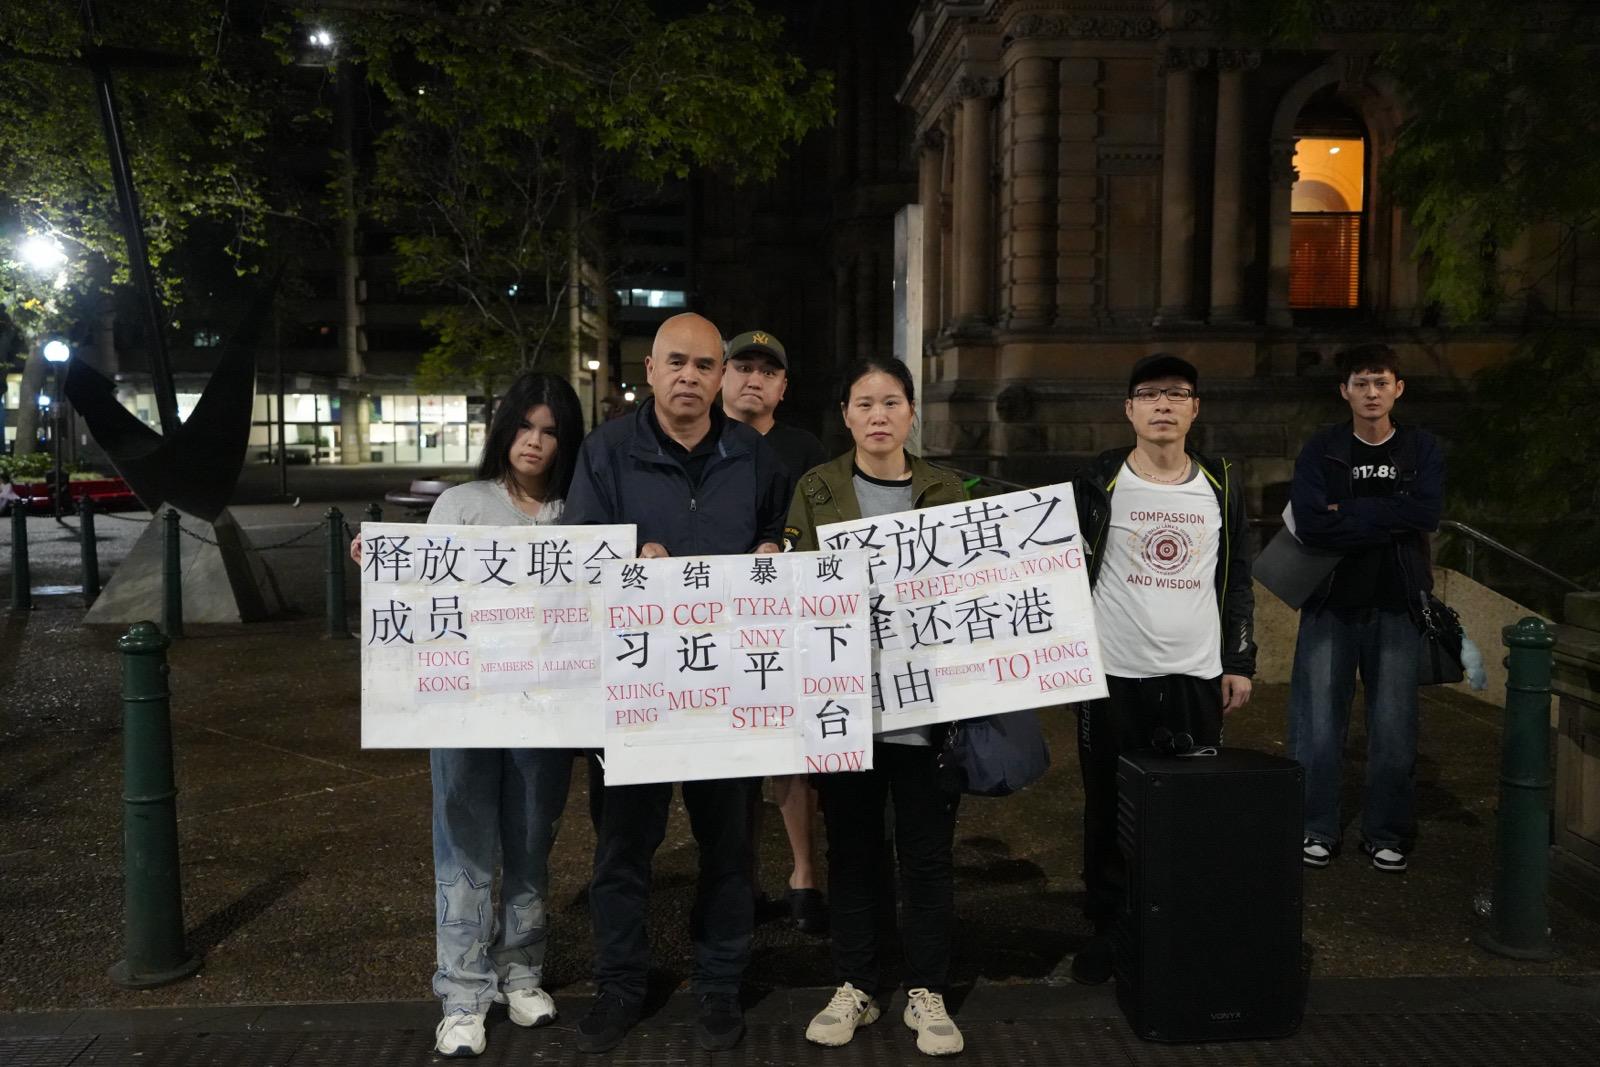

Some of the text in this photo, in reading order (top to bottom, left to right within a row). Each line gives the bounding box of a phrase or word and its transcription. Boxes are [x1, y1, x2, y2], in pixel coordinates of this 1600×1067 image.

[752, 332, 769, 345] NY
[1130, 511, 1205, 525] COMPASSION
[364, 535, 623, 586] 释放支联会
[621, 554, 844, 591] 终结暴政
[895, 548, 1083, 601] FREE JOSHUA WONG
[1126, 573, 1201, 589] AND WISDOM
[368, 595, 467, 646] 成员
[470, 606, 589, 624] RESTORE FREE
[608, 594, 861, 629] END CCP TYRA NOW
[740, 629, 786, 648] NNY
[418, 650, 470, 668] HONG
[1034, 641, 1089, 665] HONG
[480, 659, 596, 673] MEMBERS ALLIANCE
[935, 653, 1031, 683] FREEDOM TO
[418, 675, 470, 692] KONG
[1039, 667, 1093, 691] KONG
[607, 682, 665, 701] XIJING
[667, 675, 865, 729] MUST STEP DOWN
[616, 707, 658, 725] PING
[805, 751, 866, 774] NOW
